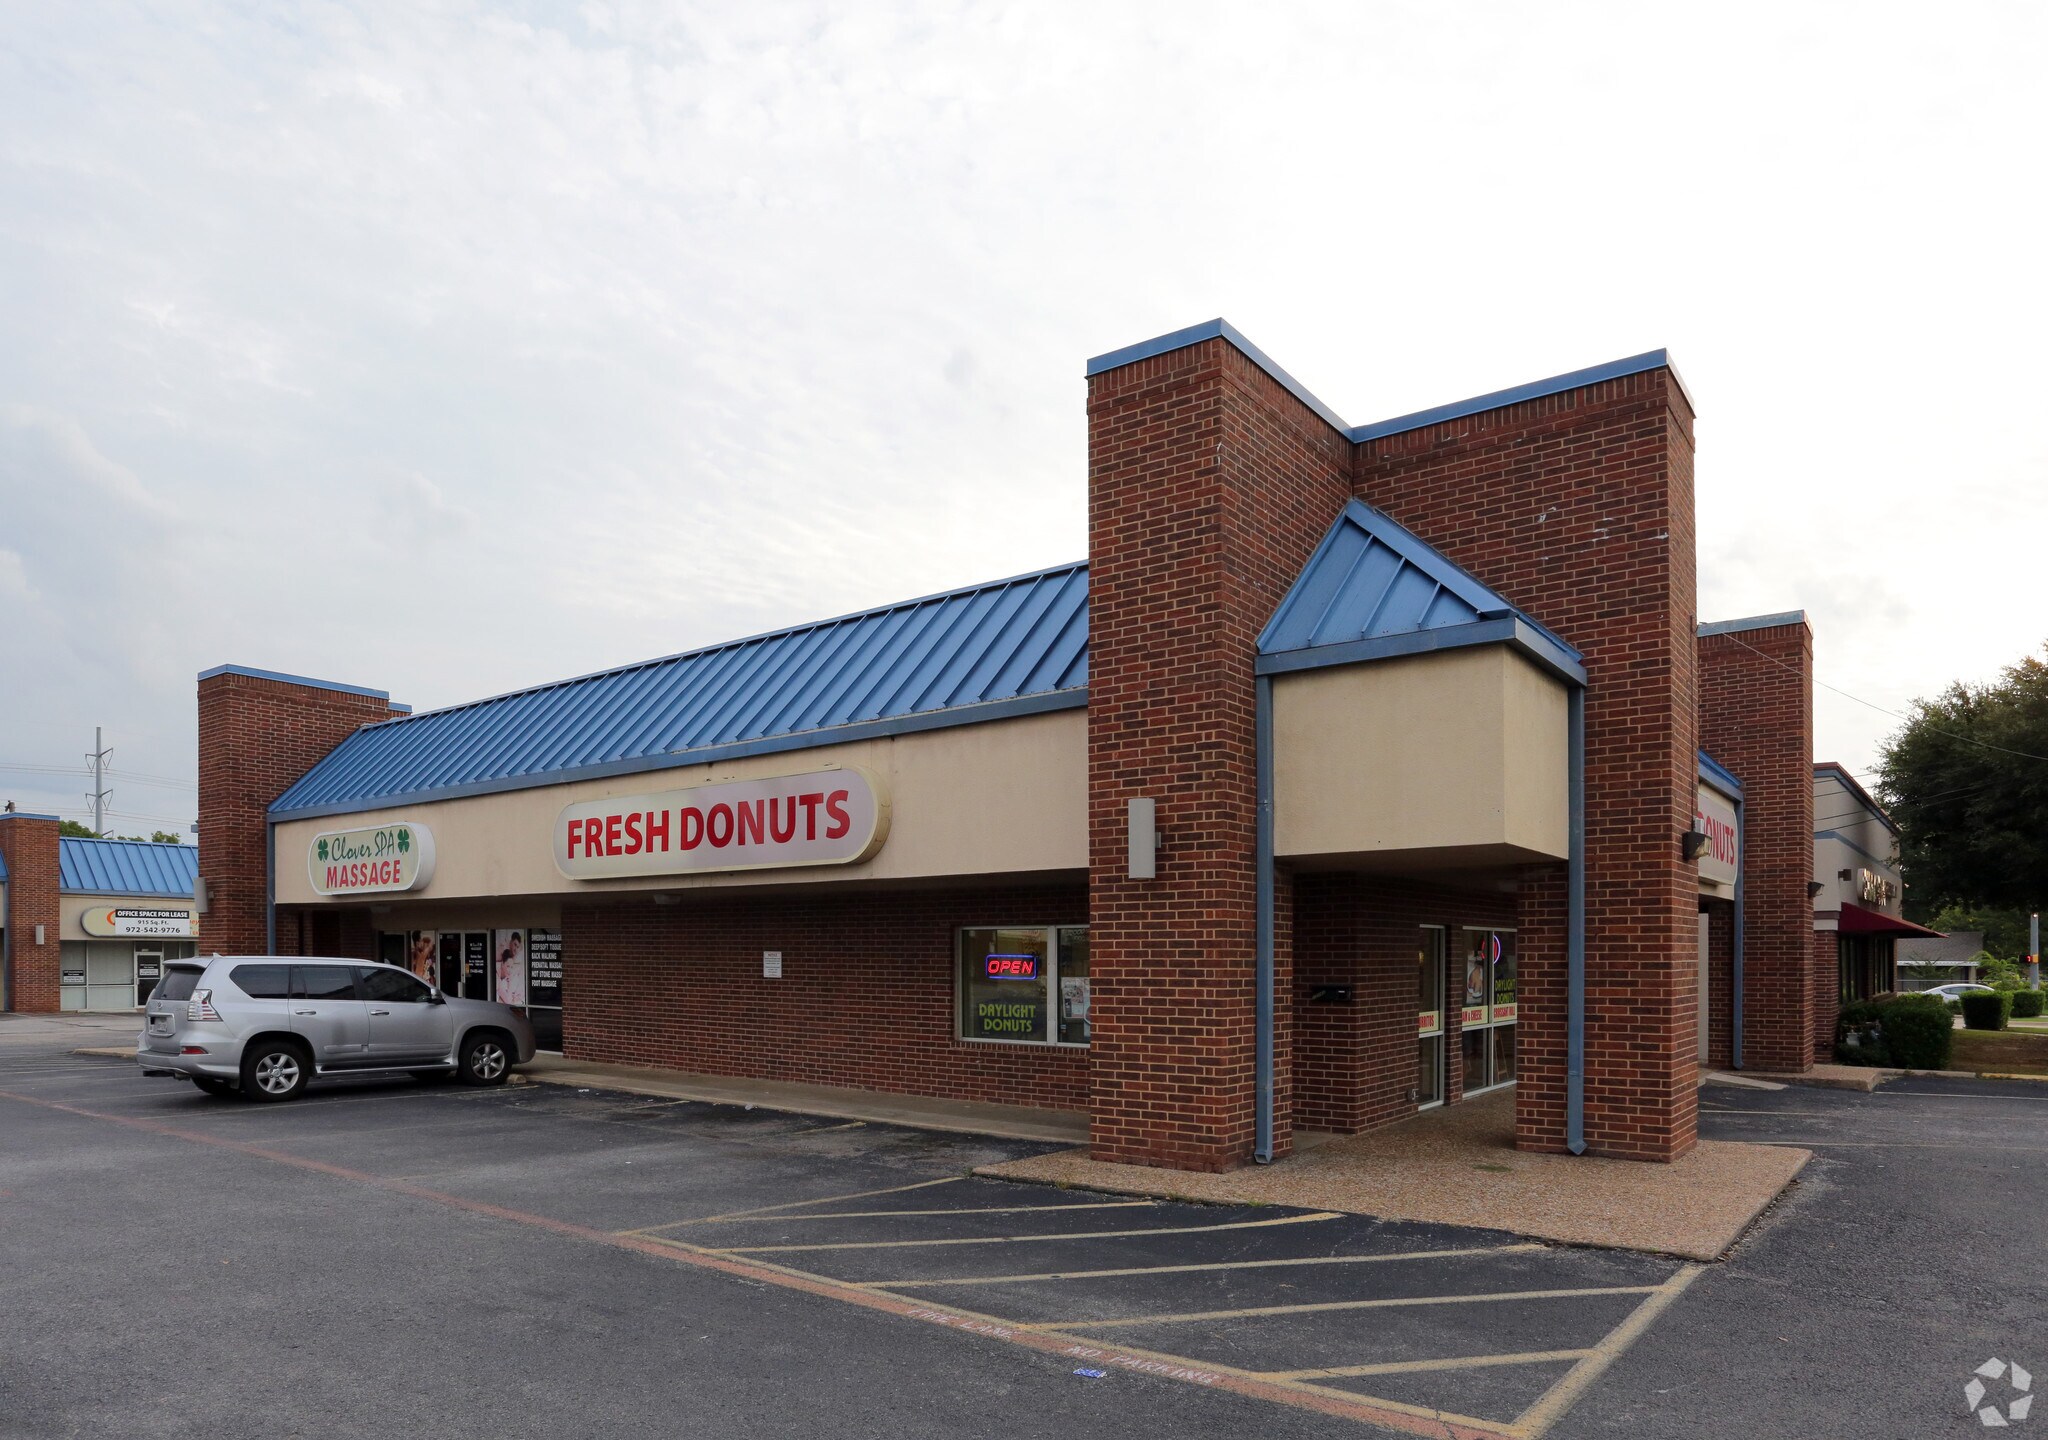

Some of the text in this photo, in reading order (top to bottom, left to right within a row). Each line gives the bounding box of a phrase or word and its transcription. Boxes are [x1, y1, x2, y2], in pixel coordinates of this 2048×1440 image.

[567, 789, 850, 859] FRESH DONUTS
[1697, 811, 1734, 865] ONUTS
[332, 830, 395, 861] Clover SPA
[326, 860, 400, 888] MASSAGE
[987, 960, 1035, 975] OPEN
[978, 1003, 1036, 1018] DAYLIGHT
[983, 1018, 1033, 1032] DONUTS
[907, 1309, 959, 1323] FIRE
[1065, 1345, 1102, 1358] NO
[1109, 1355, 1219, 1385] PARKING
